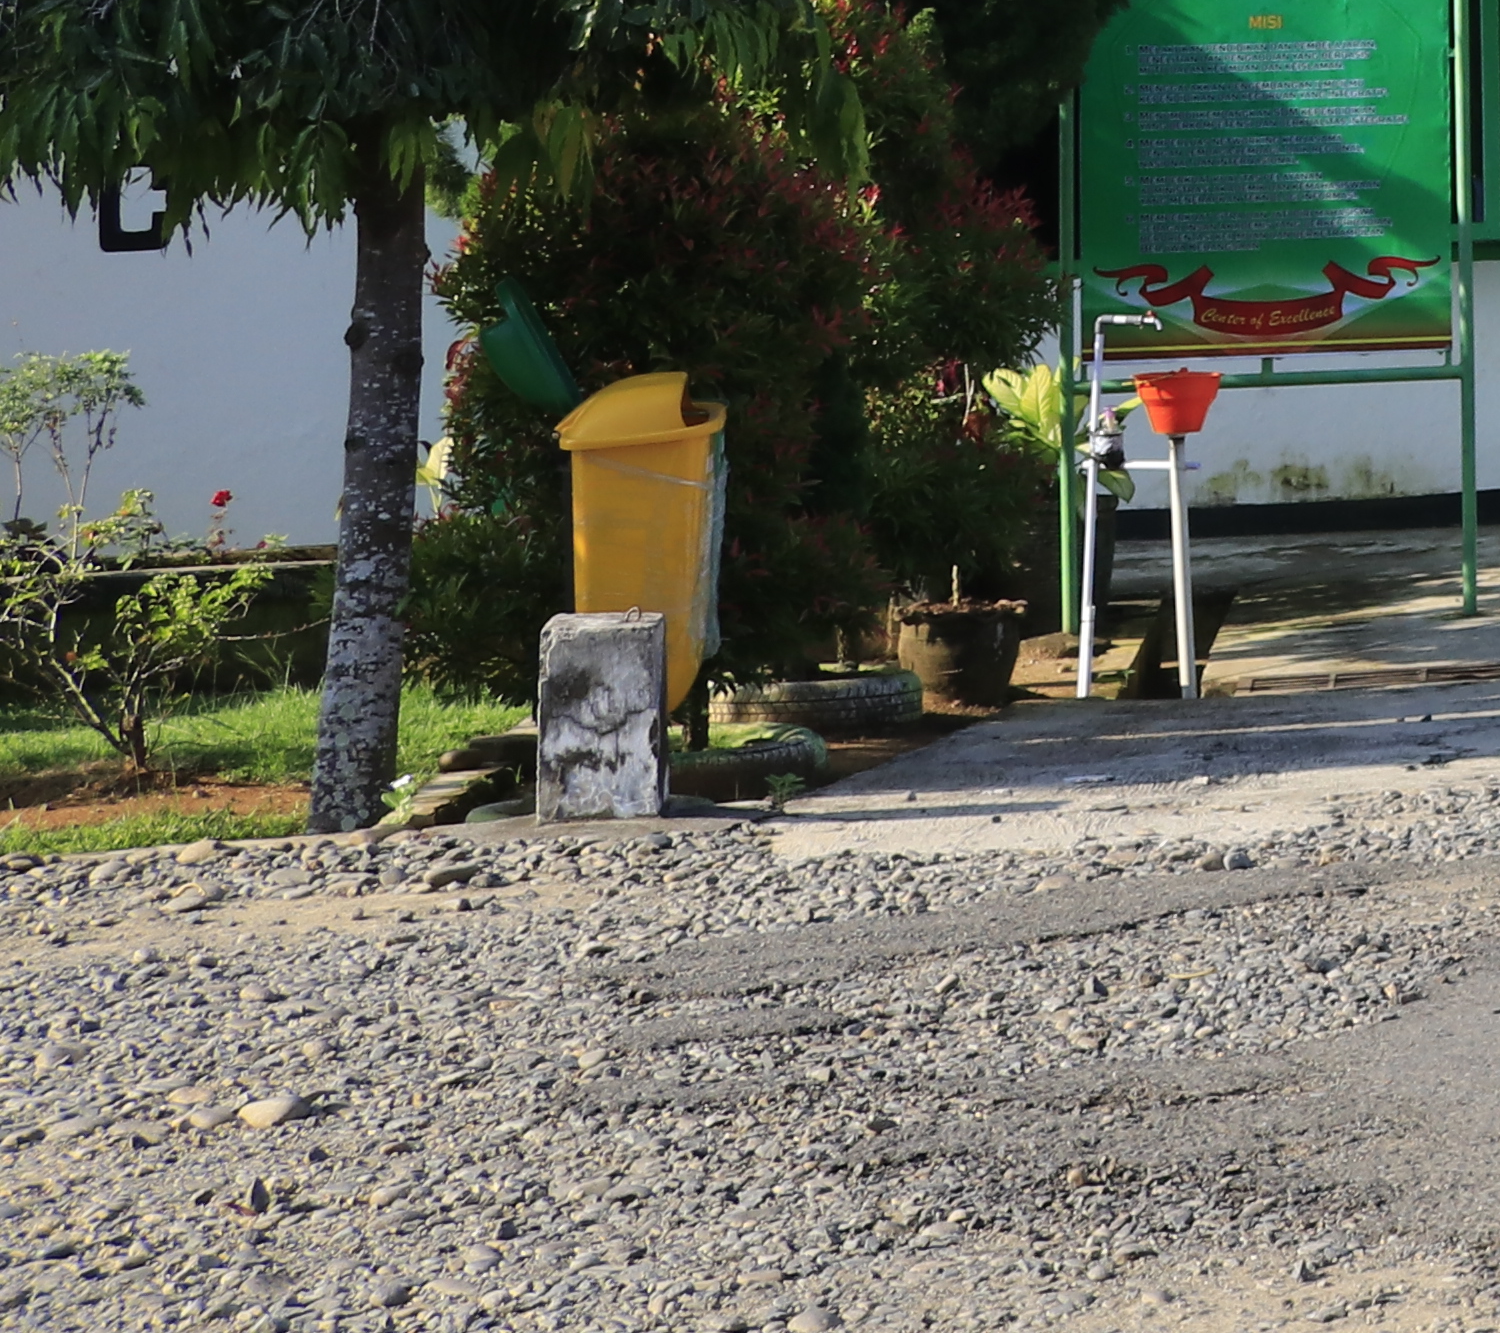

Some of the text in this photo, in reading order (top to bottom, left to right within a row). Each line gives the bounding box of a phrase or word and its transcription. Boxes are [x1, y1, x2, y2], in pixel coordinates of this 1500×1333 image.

[1249, 15, 1282, 29] MISI
[1201, 305, 1336, 329] Center of Excellence
